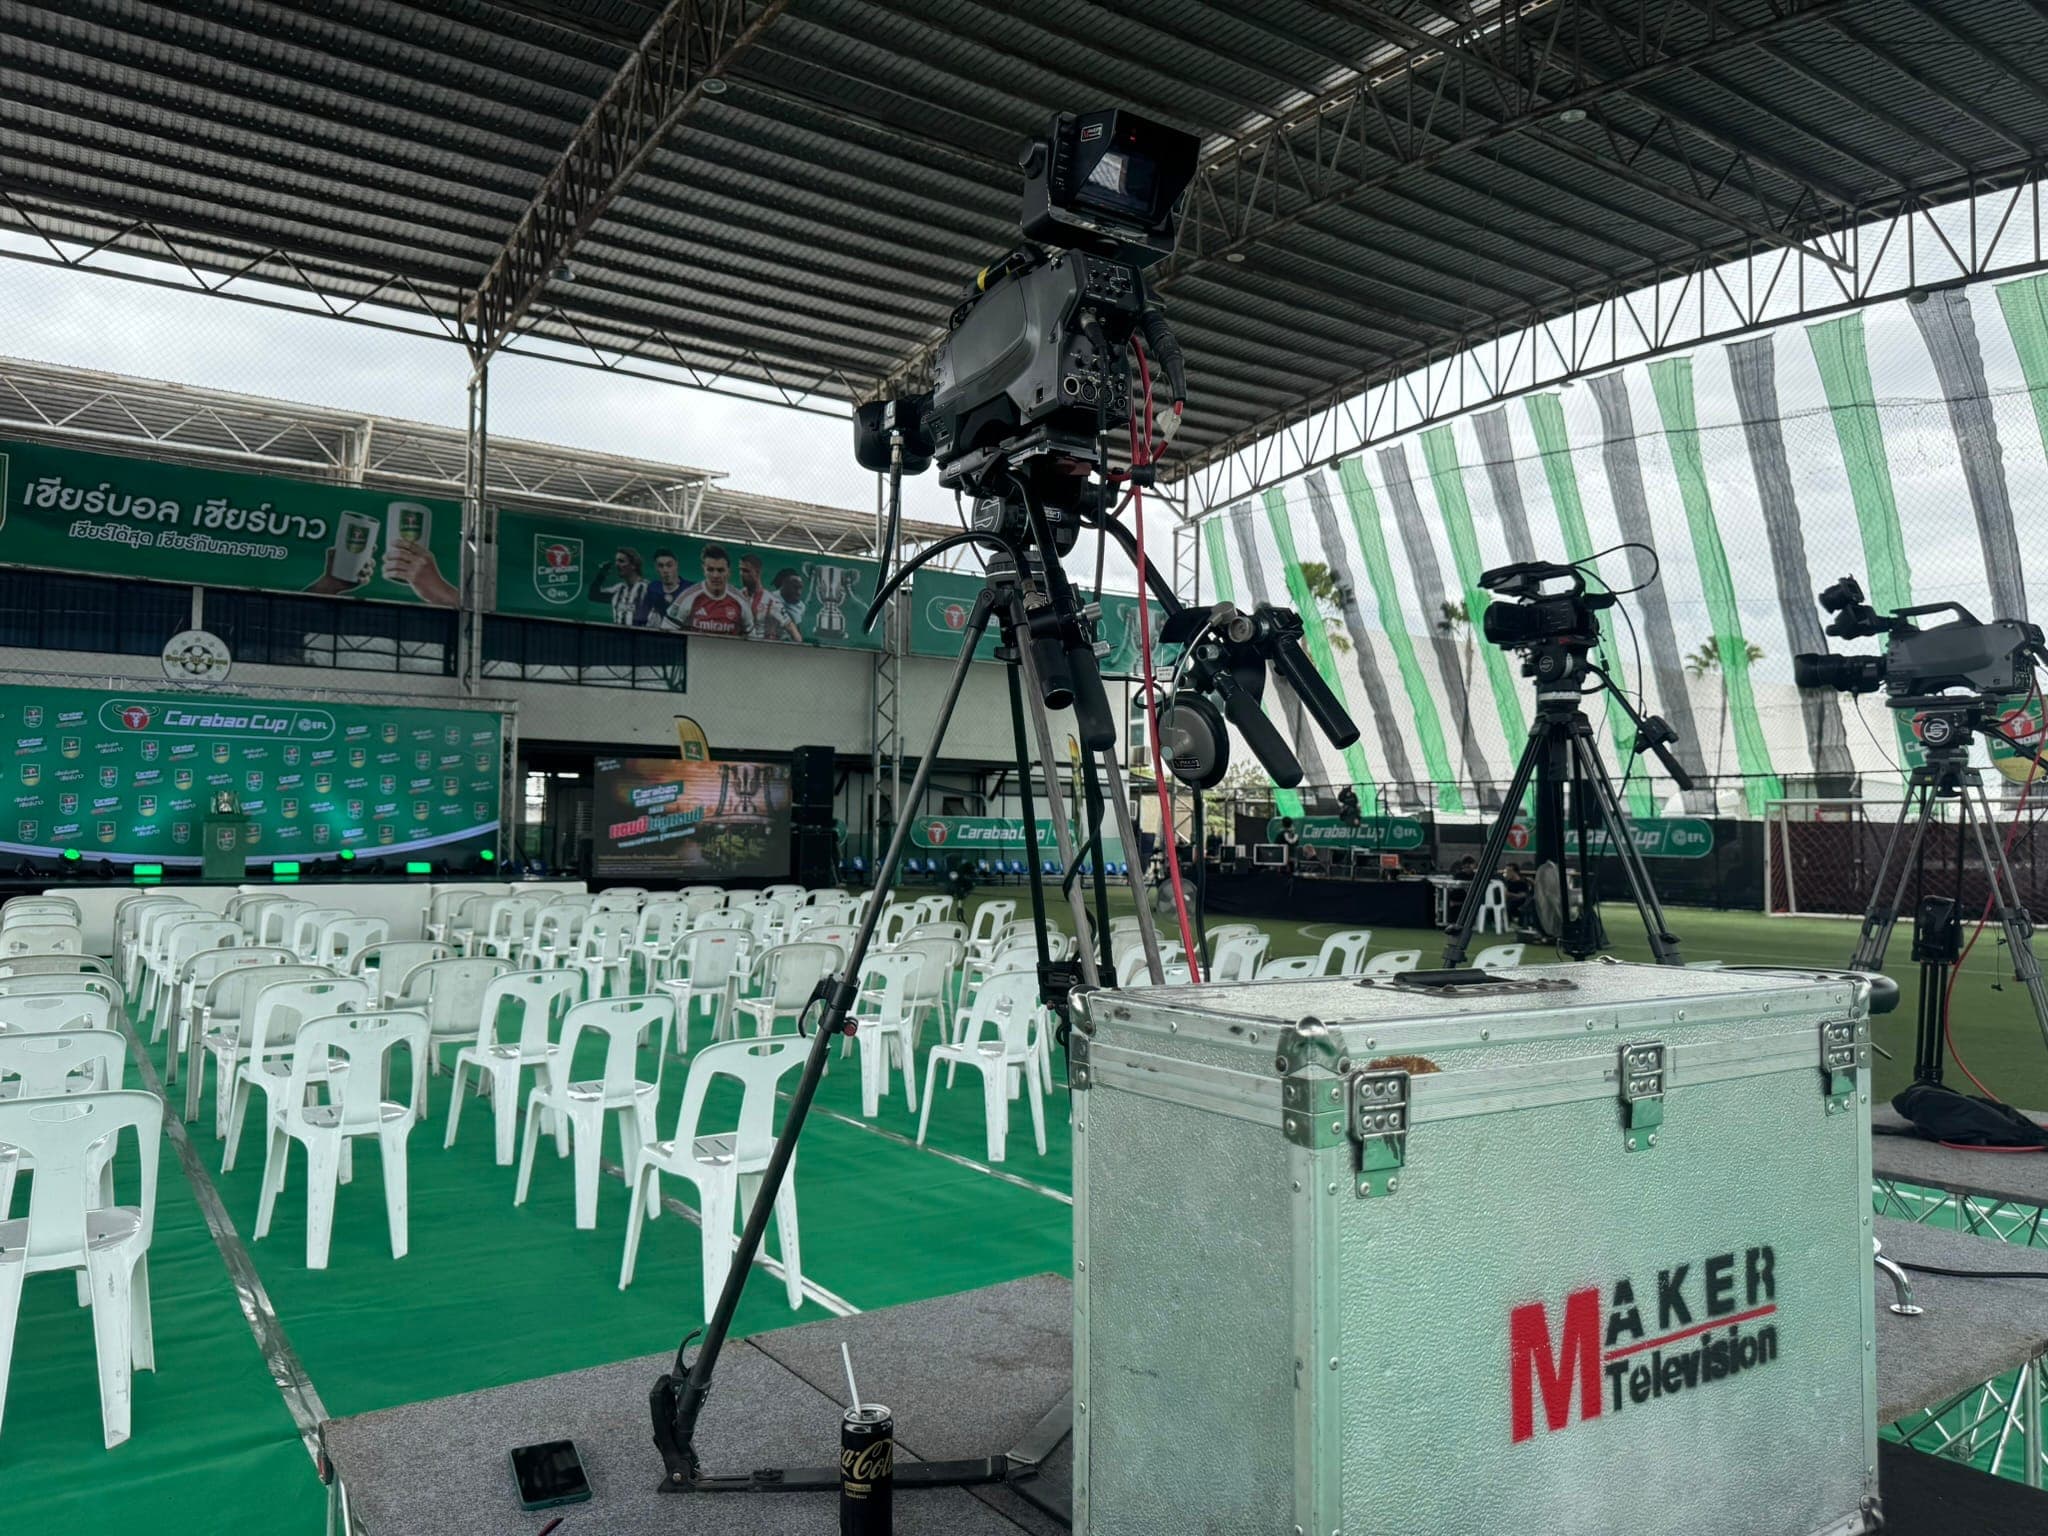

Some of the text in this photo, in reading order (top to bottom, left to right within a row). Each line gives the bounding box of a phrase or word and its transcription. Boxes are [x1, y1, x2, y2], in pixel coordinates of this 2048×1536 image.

[23, 477, 327, 540] เชียร์บอล เชียร์บาว
[163, 710, 249, 729] Carabao
[249, 714, 289, 734] Cup
[1018, 825, 1046, 842] Cp
[1604, 1325, 1778, 1412] Television
